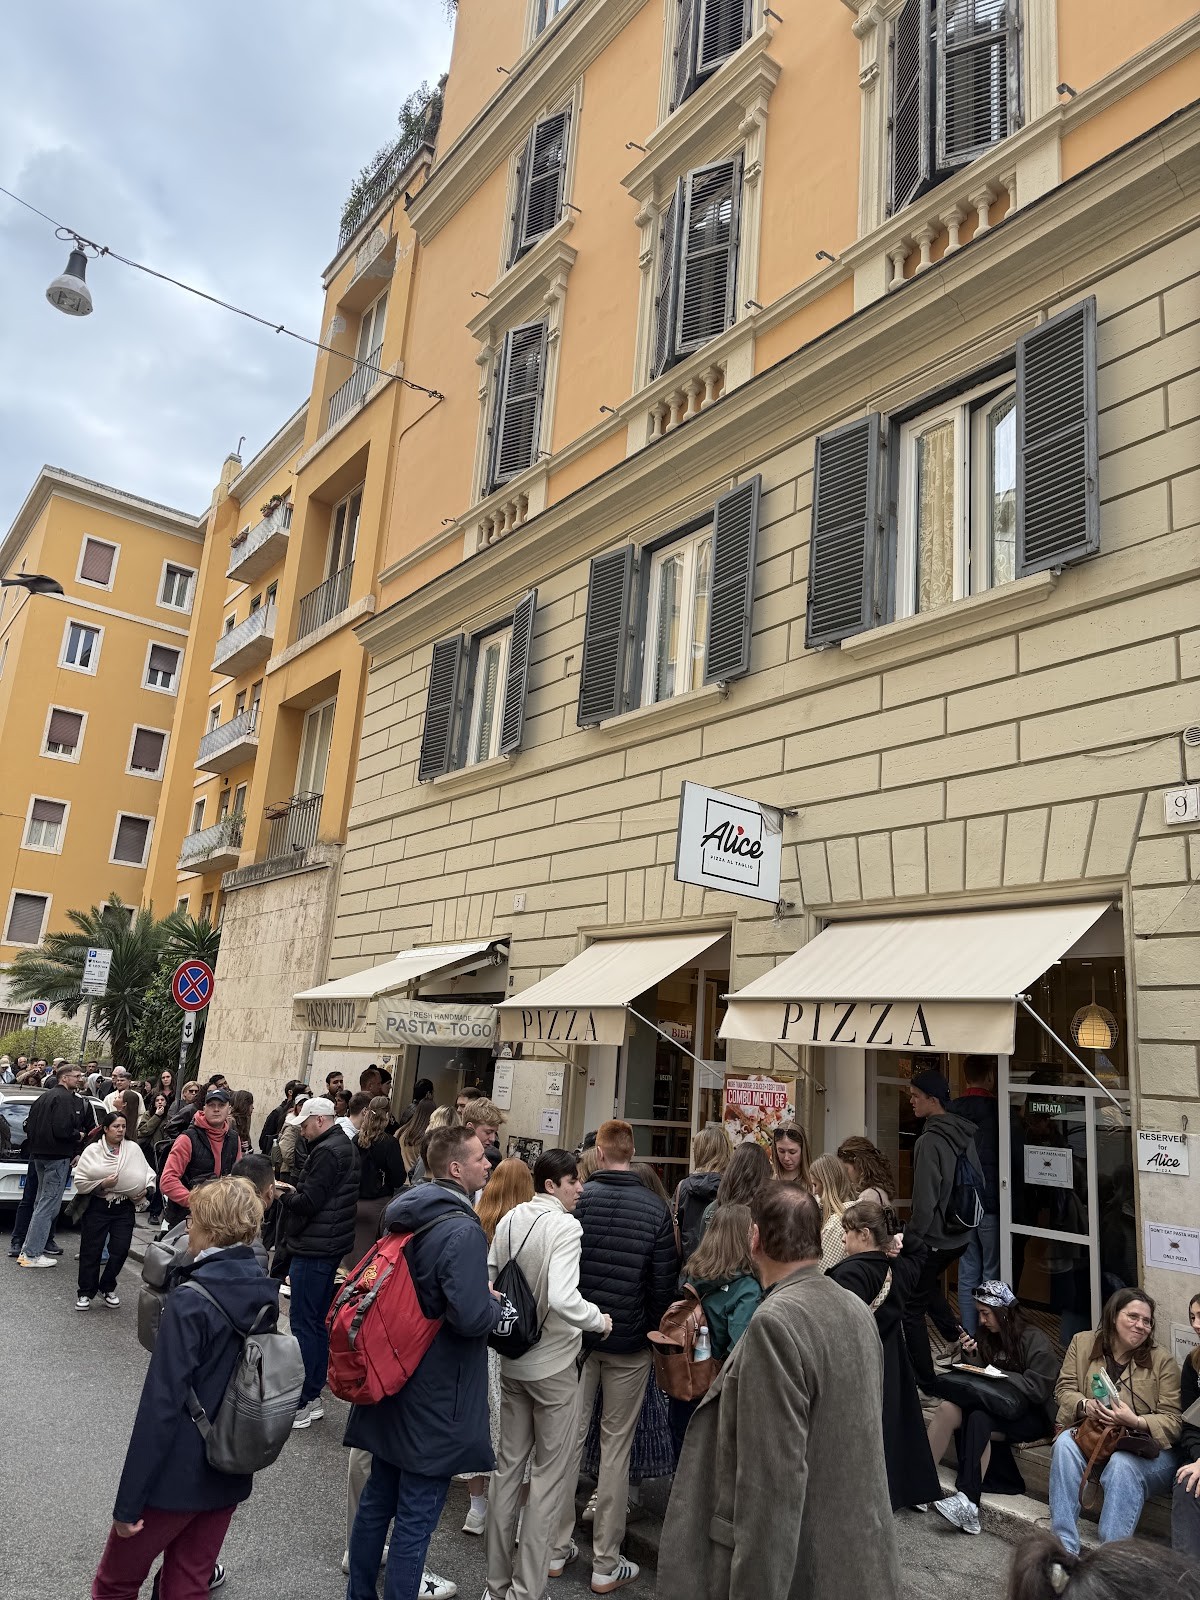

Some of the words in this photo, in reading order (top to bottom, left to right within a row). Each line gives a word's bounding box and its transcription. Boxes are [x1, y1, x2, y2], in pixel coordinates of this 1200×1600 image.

[1174, 795, 1187, 817] 9
[700, 820, 764, 859] Alice
[710, 855, 725, 863] PIZZA
[735, 861, 754, 870] TAGLIO
[409, 1011, 433, 1019] FRESH
[386, 1017, 438, 1035] PASTA
[521, 1009, 599, 1041] PIZZA
[777, 1002, 936, 1046] PIZZA
[728, 1090, 751, 1105] COMBO
[753, 1092, 774, 1106] MENU
[775, 1093, 785, 1107] 8€
[1032, 1102, 1062, 1113] ENTRATA
[1146, 1152, 1180, 1167] Alice
